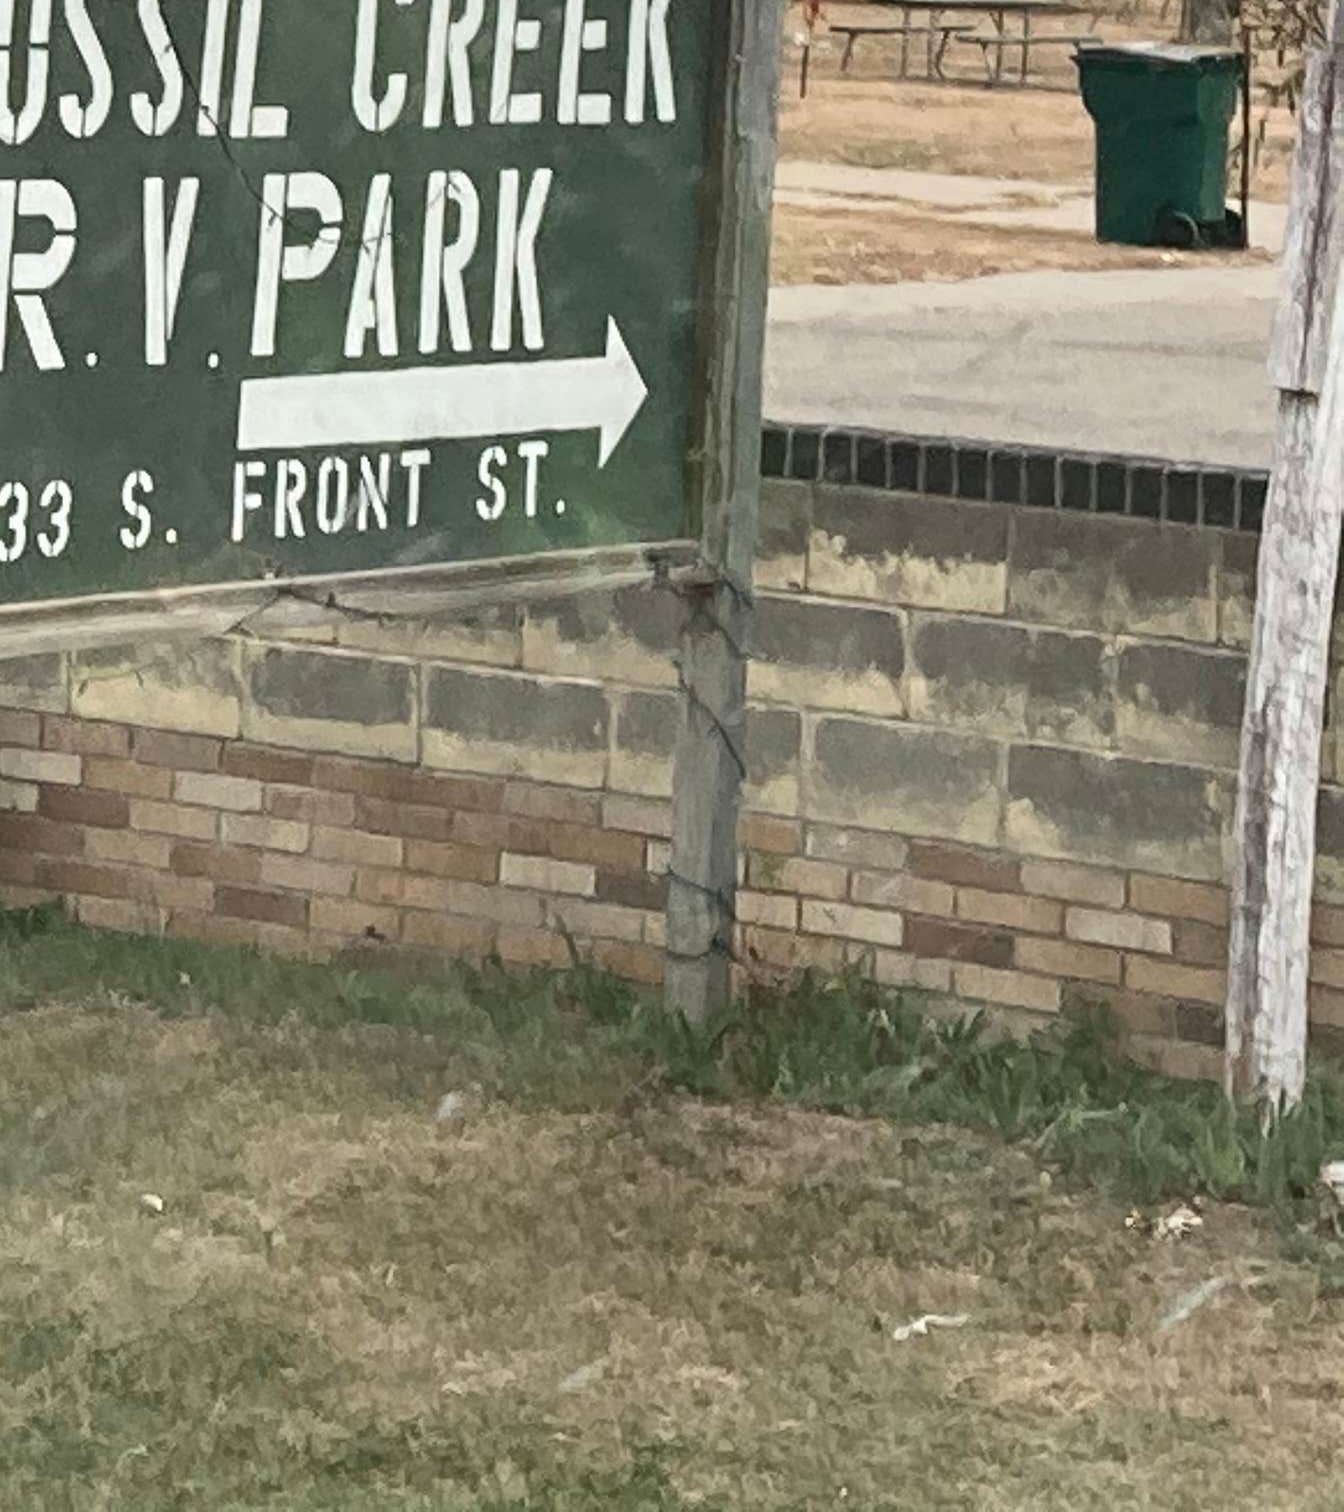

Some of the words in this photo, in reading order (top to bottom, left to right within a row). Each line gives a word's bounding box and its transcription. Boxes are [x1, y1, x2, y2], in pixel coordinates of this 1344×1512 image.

[249, 167, 553, 358] PARK
[119, 469, 178, 550] S.
[231, 448, 432, 542] FRONT
[475, 440, 568, 521] ST.
